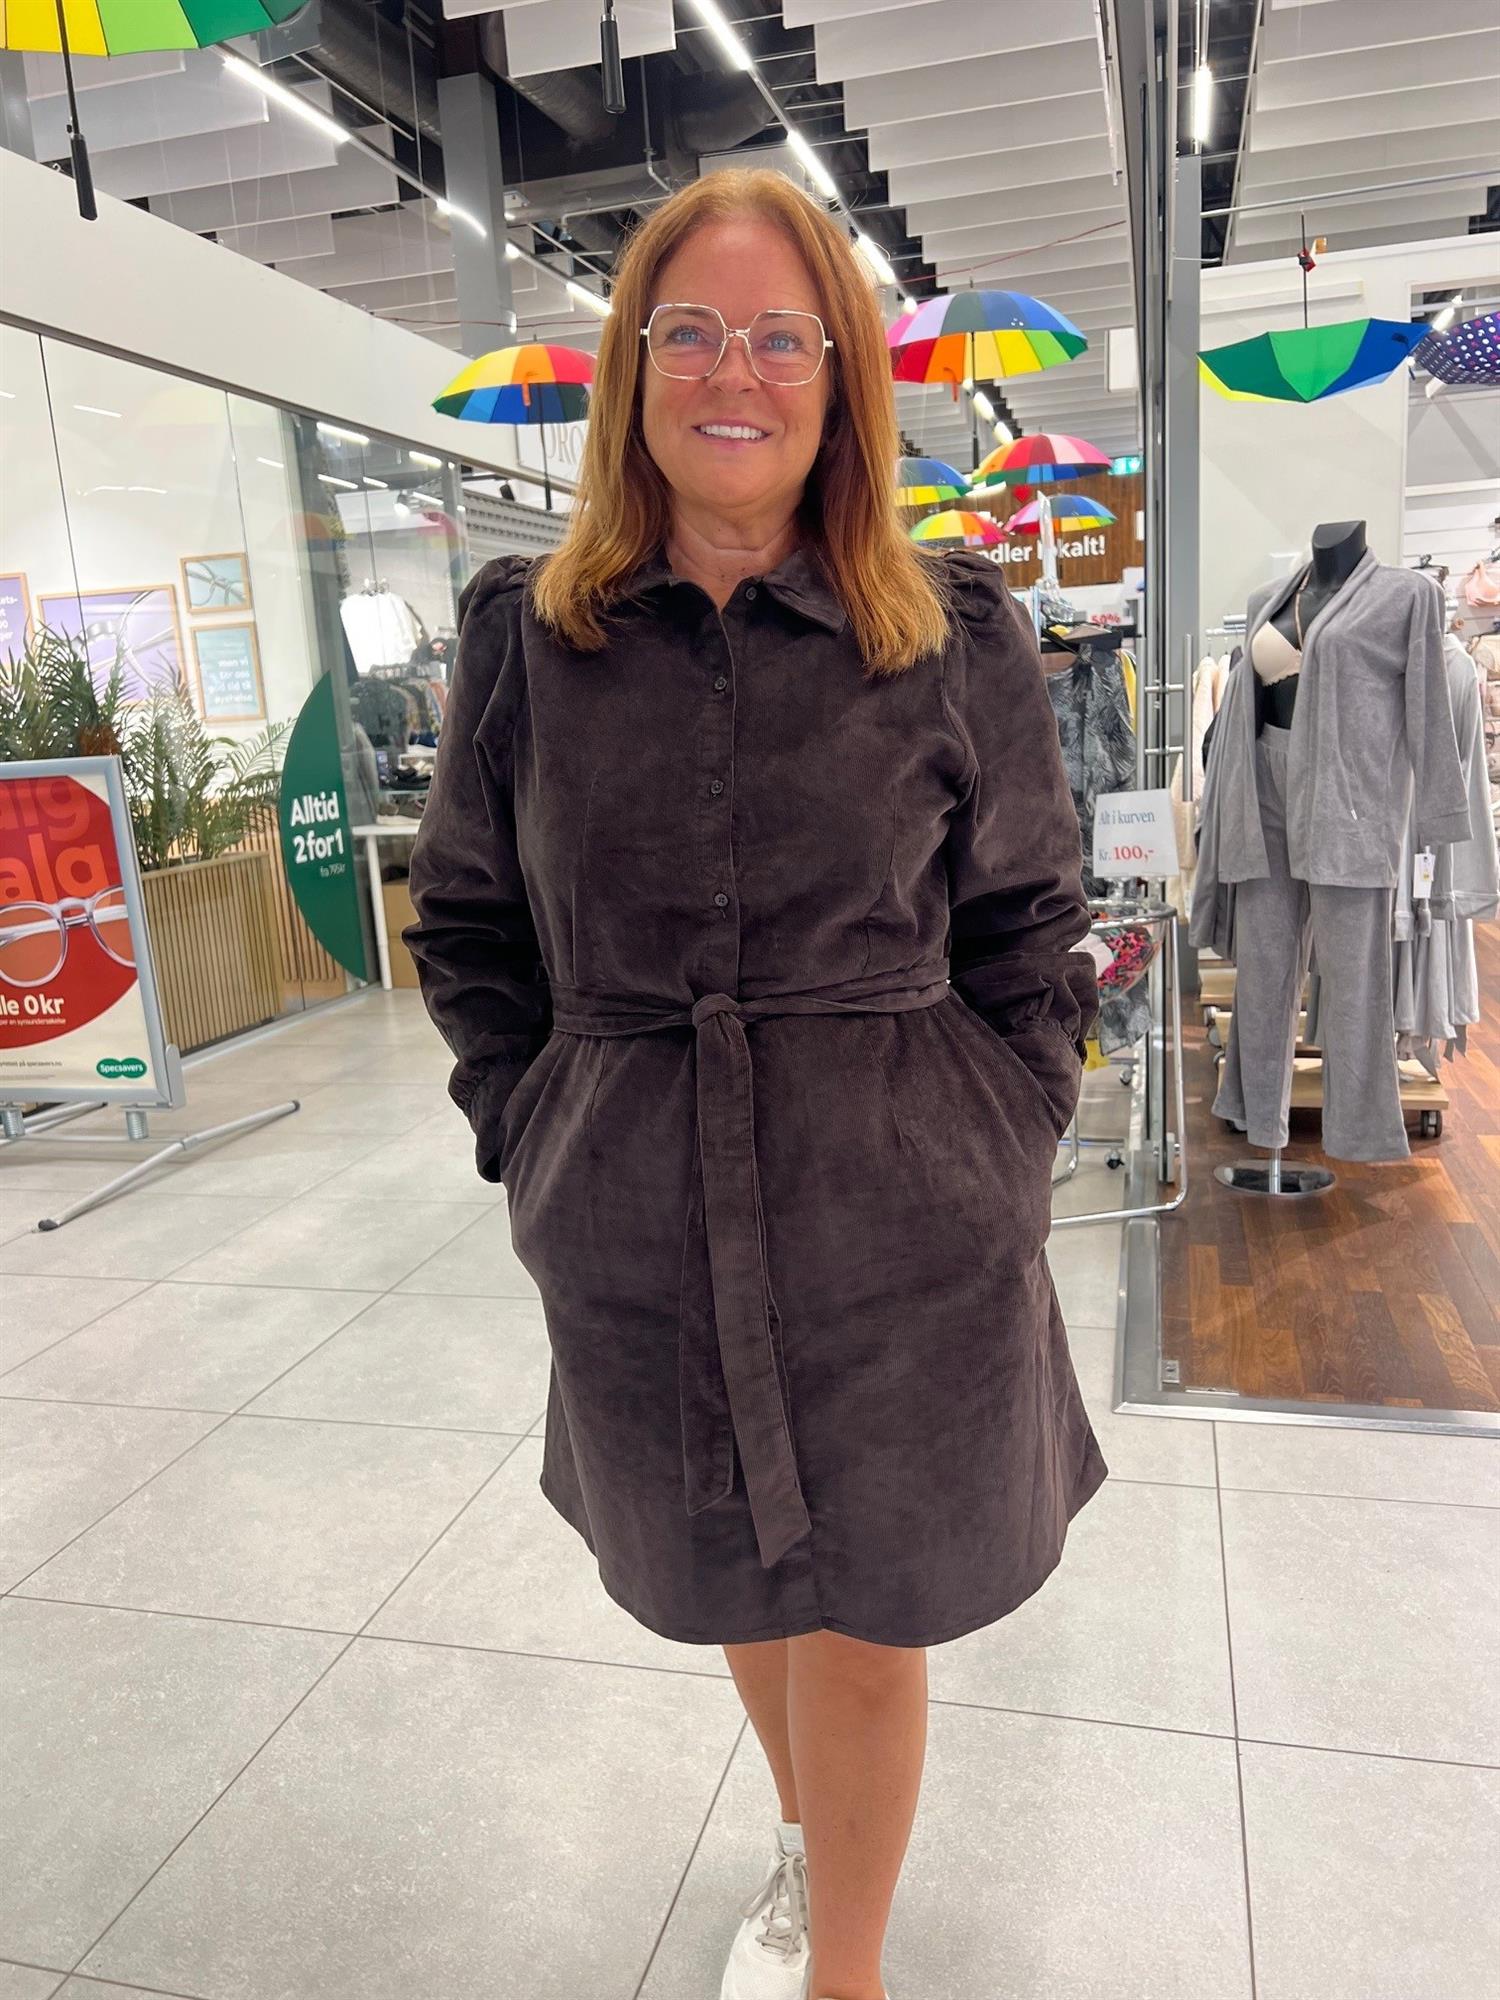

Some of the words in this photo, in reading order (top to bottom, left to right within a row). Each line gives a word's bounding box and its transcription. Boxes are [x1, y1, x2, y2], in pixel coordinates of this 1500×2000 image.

[1037, 534, 1105, 560] lkalt!
[291, 791, 340, 827] Alltid
[1118, 810, 1155, 824] kurven
[1114, 845, 1154, 862] 100,-
[100, 1062, 144, 1074] Specsavers
